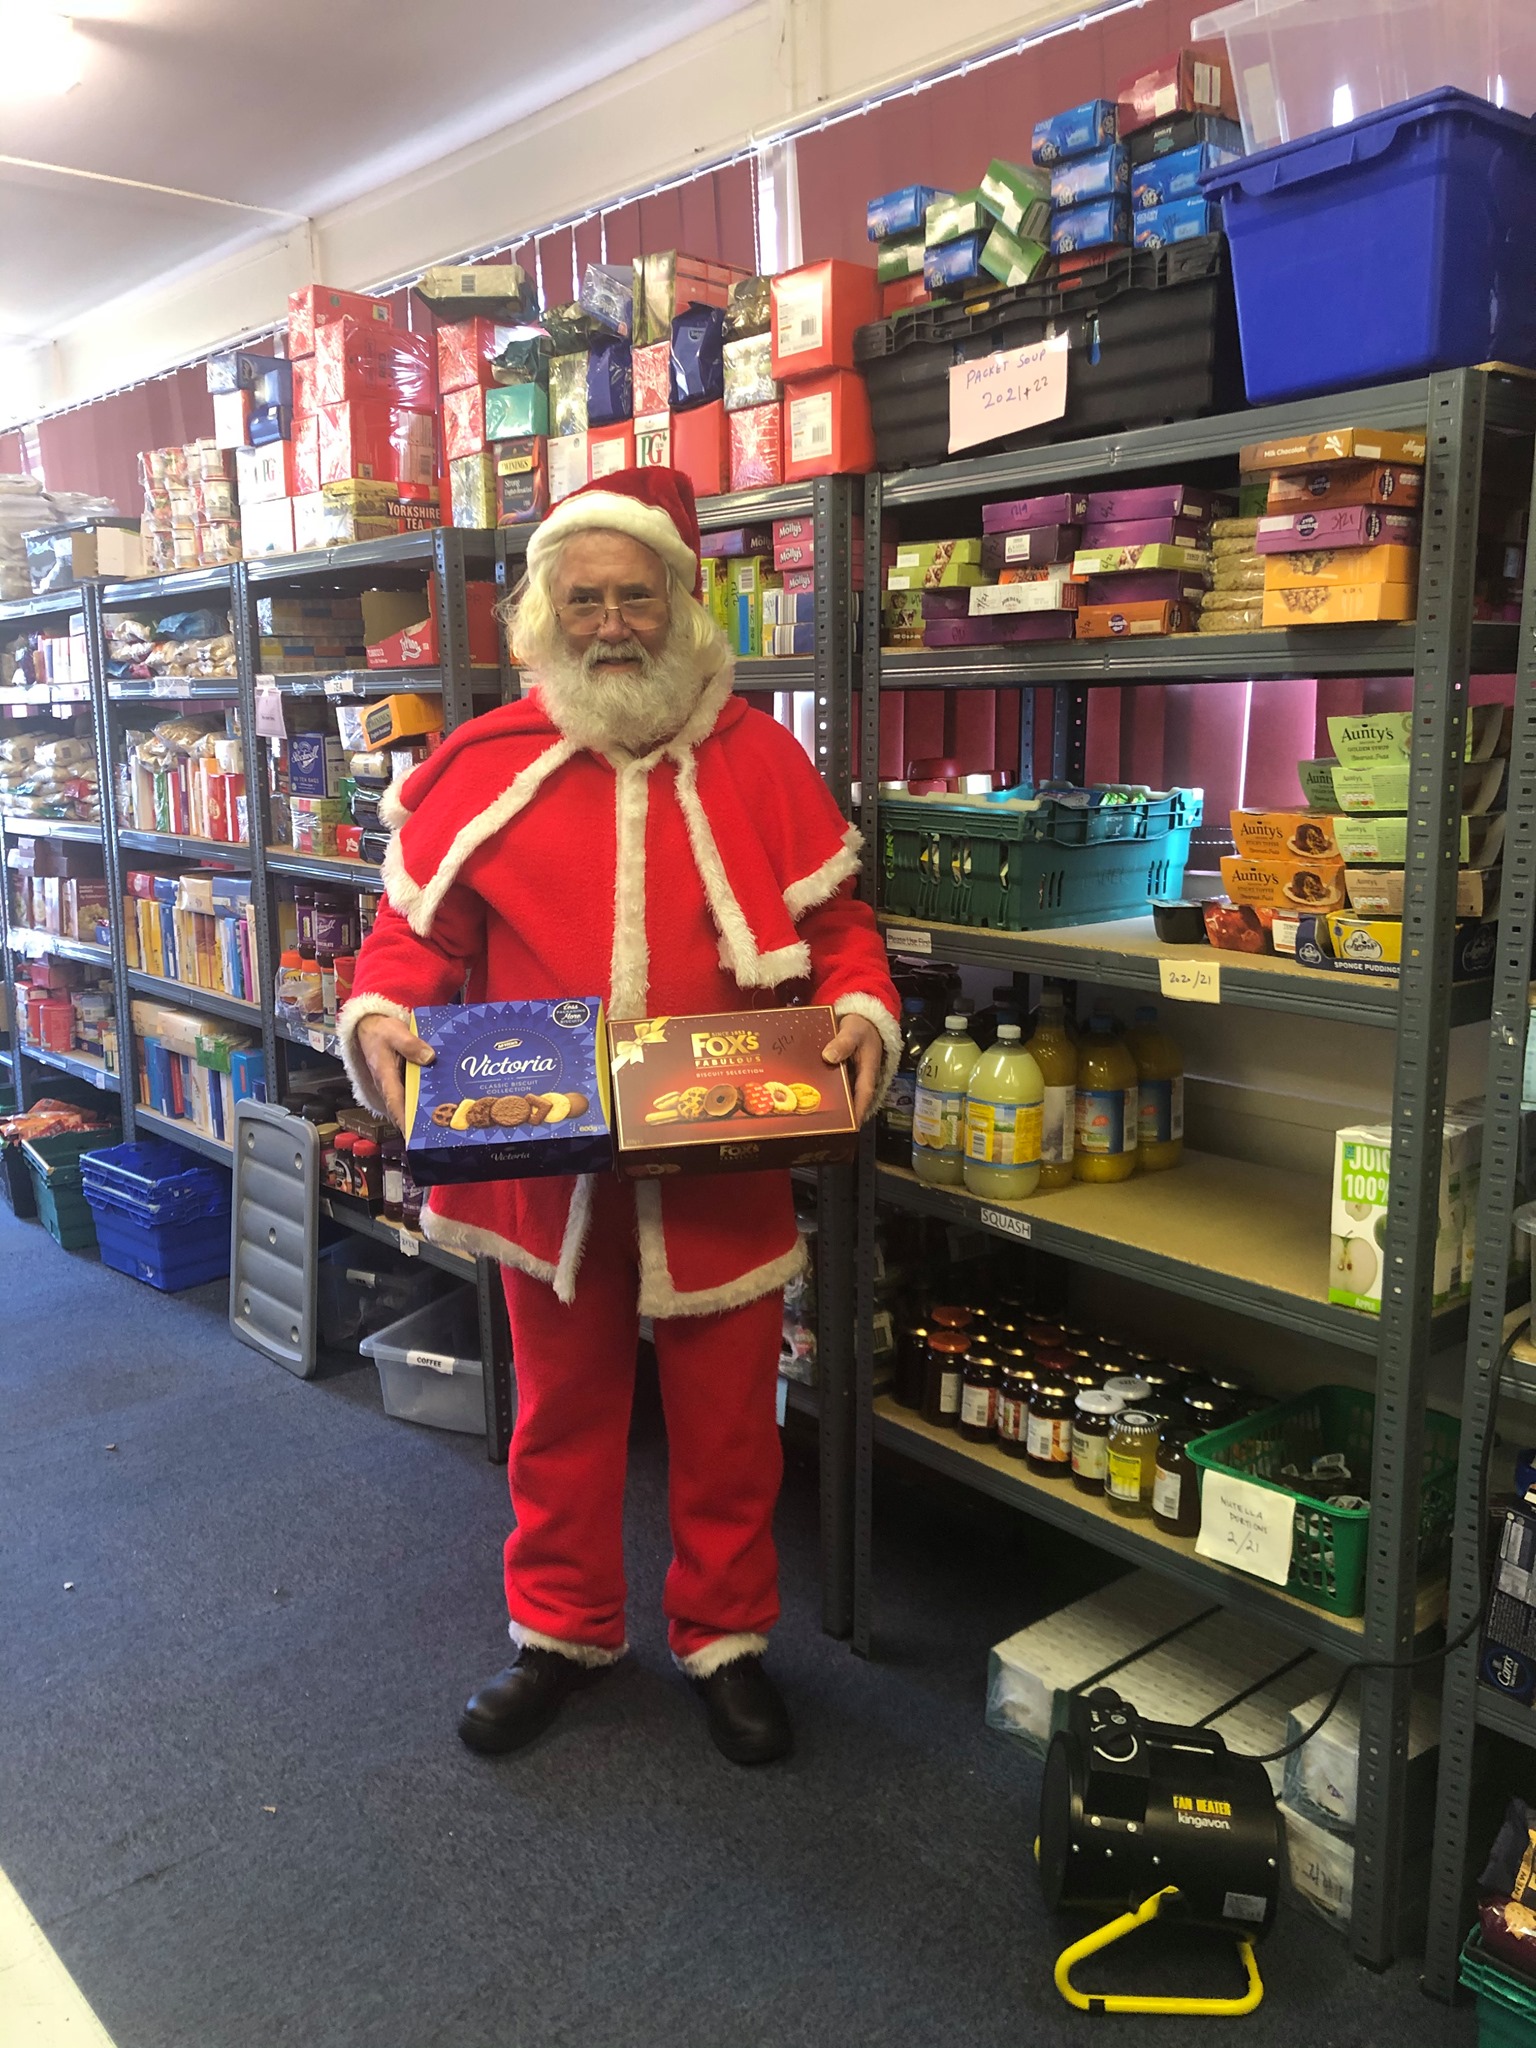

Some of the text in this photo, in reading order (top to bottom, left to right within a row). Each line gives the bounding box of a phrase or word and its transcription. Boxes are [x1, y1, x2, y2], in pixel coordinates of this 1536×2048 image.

[966, 348, 1046, 389] PACKET SOUP
[641, 433, 663, 467] PG
[1264, 446, 1306, 458] Milk Chocolate
[504, 478, 521, 489] Strong
[387, 502, 441, 519] YORKSHIRE
[406, 518, 424, 530] TEA
[779, 521, 802, 537] Molly's
[751, 535, 773, 550] Molly
[780, 547, 802, 563] Molly's
[788, 572, 811, 588] Molly's
[1341, 727, 1394, 744] Aunty's
[1306, 773, 1332, 786] Aunt
[1241, 822, 1284, 840] Aunty's
[1232, 869, 1279, 885] Aunty's
[1334, 961, 1363, 971] SPONGE
[562, 1012, 581, 1021] More
[461, 1054, 557, 1078] Victoria
[695, 1055, 761, 1067] FABULOUS
[696, 1070, 724, 1078] BISCUIT
[479, 1082, 509, 1091] CLASSIC
[486, 1087, 532, 1095] COLLECTION
[491, 1151, 530, 1162] Victoria
[1350, 1146, 1391, 1173] JUIC
[982, 1209, 1030, 1238] SQUASH
[1355, 1298, 1376, 1310] APPLE
[417, 1356, 442, 1368] COFFEE
[1220, 1495, 1263, 1520] NUTELLA
[1227, 1531, 1259, 1554] 2/21
[1497, 1655, 1514, 1687] Carr's
[1173, 1795, 1232, 1816] FAN HEATER
[1178, 1811, 1231, 1830] kingavon
[1514, 1872, 1527, 1895] NEW
